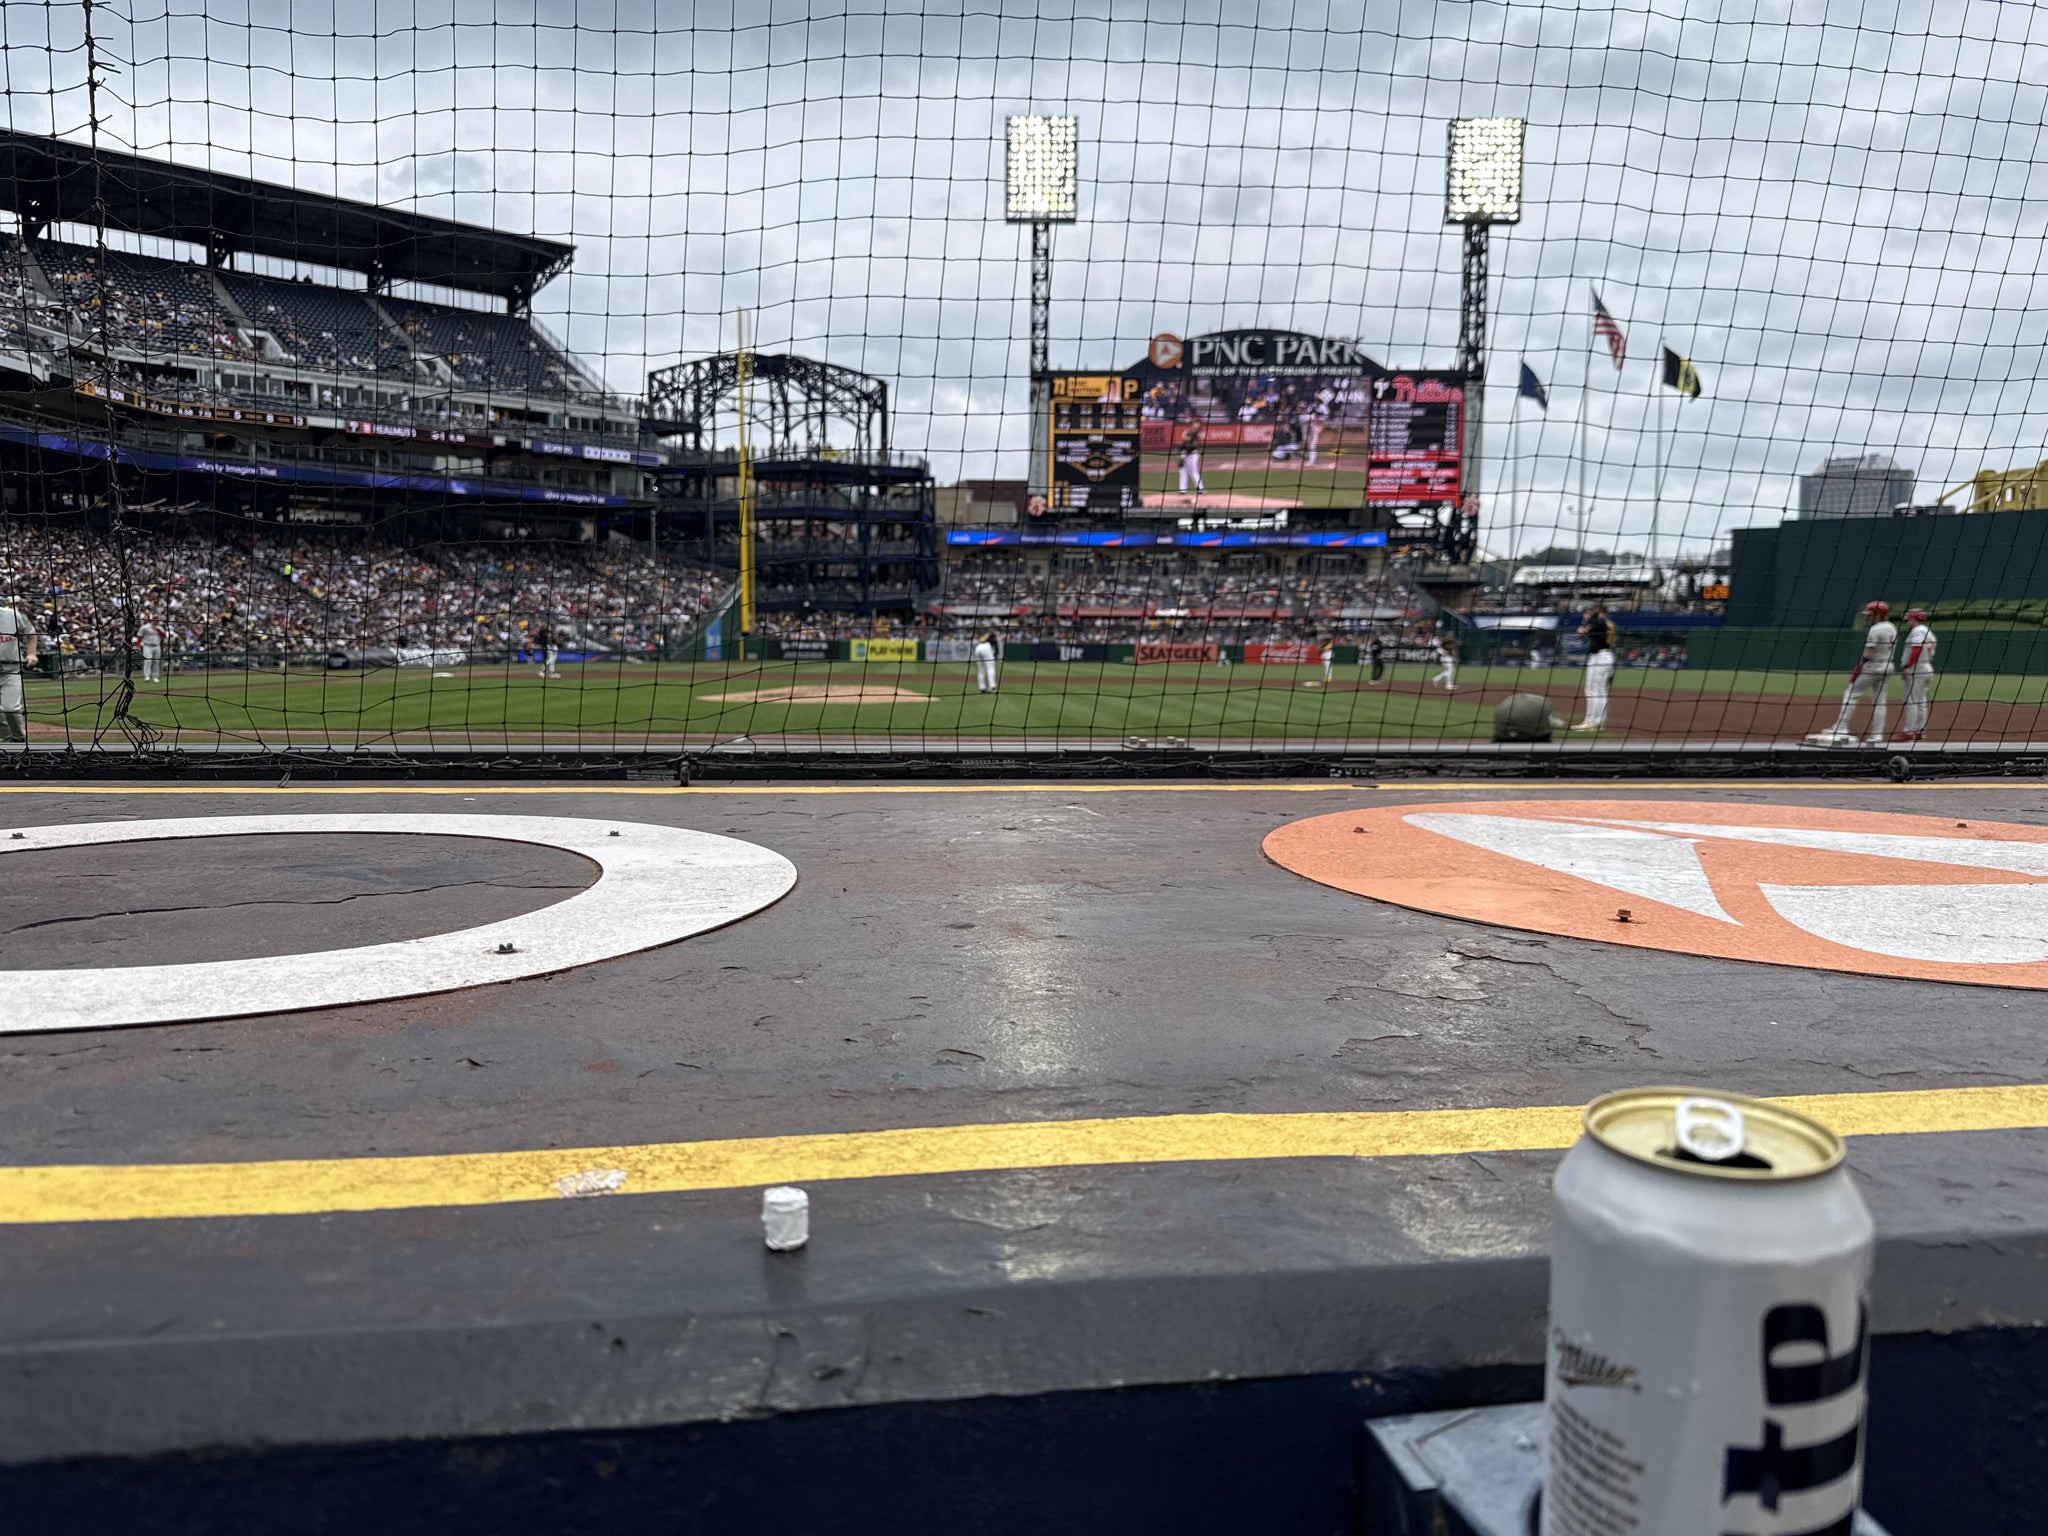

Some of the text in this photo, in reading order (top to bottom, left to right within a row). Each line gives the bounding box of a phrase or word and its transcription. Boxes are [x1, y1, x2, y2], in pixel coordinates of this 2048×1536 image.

[1191, 335, 1364, 365] PNC PARK
[1191, 367, 1219, 377] HOME
[1222, 367, 1236, 377] OF
[1239, 367, 1257, 377] THE
[1060, 645, 1084, 661] Lite
[1140, 645, 1213, 661] SEATGEEK
[1554, 1328, 1643, 1393] Miller
